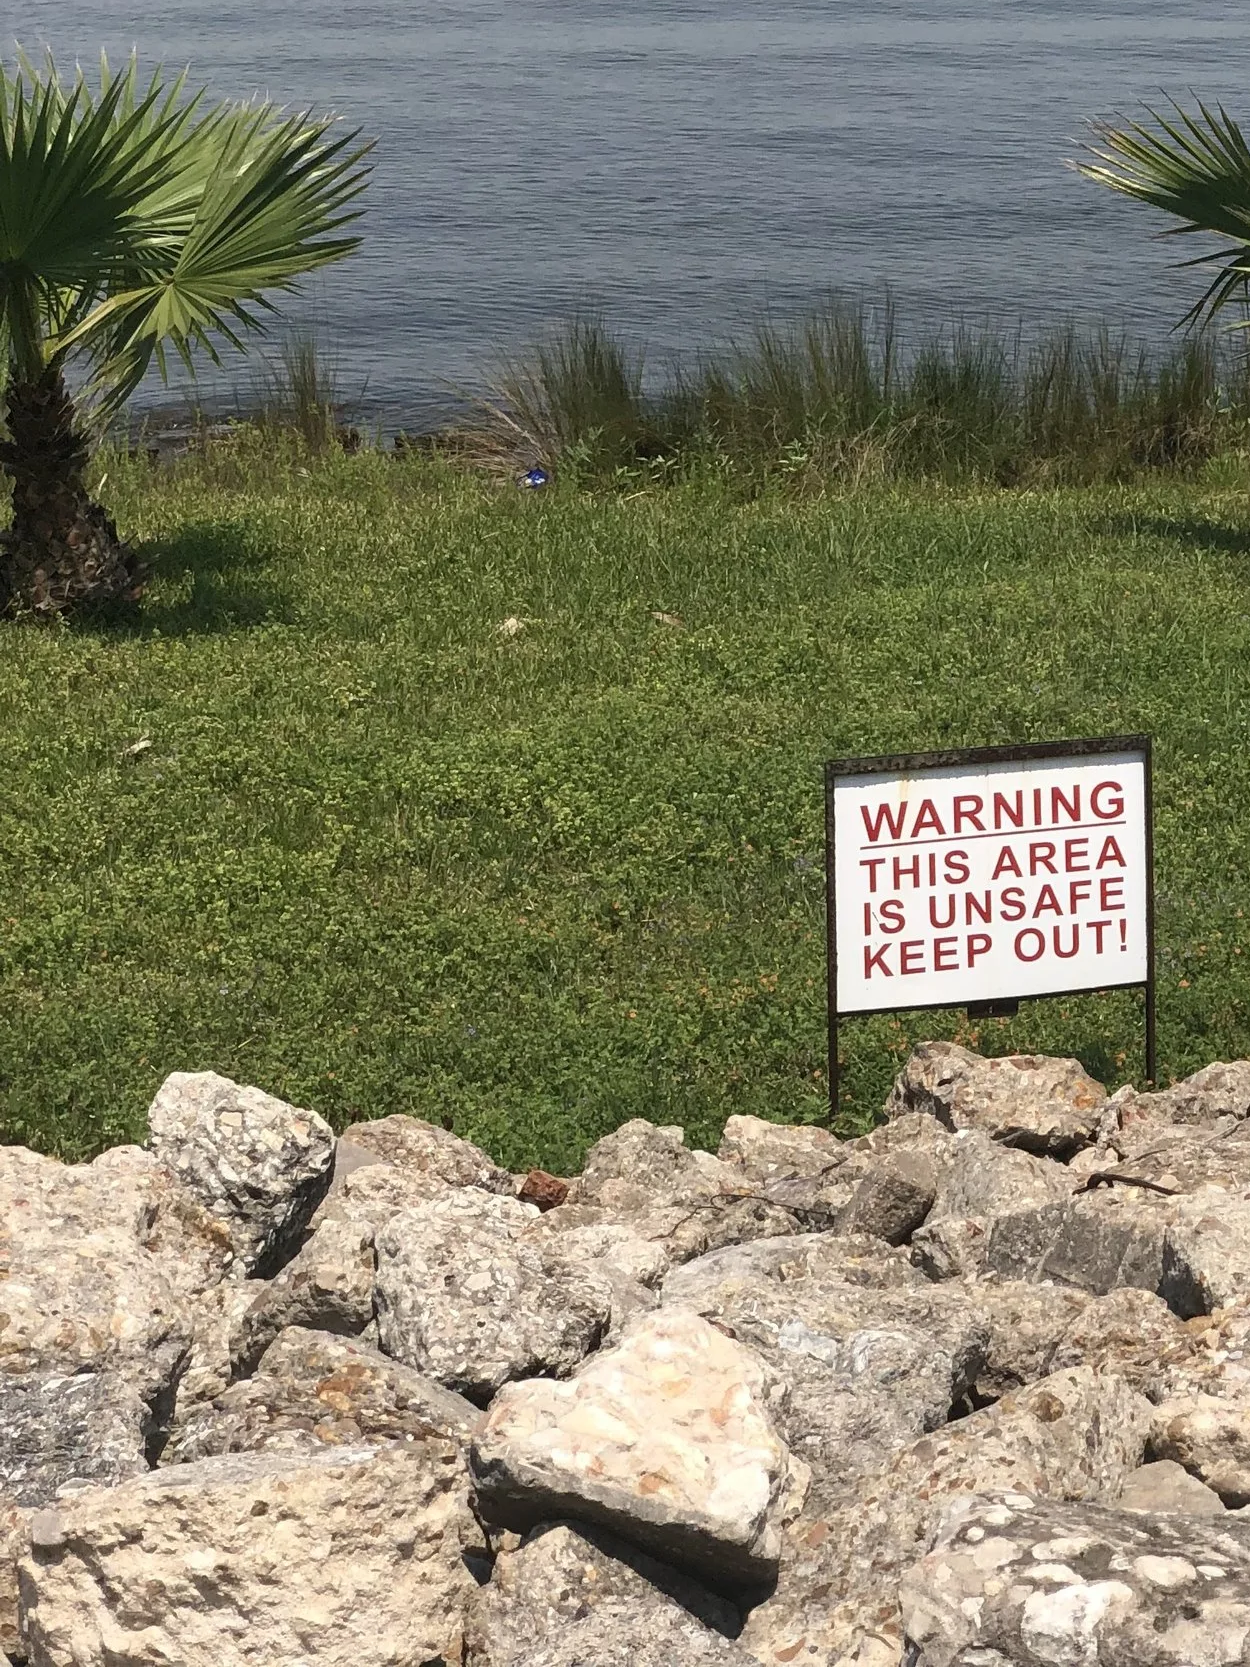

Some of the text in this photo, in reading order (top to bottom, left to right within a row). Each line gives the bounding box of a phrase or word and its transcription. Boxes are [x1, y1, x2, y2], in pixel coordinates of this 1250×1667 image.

[860, 781, 1124, 842] WARNING
[859, 835, 1127, 893] THIS AREA
[863, 876, 1125, 936] IS UNSAFE
[863, 918, 1127, 979] KEEP OUT!
